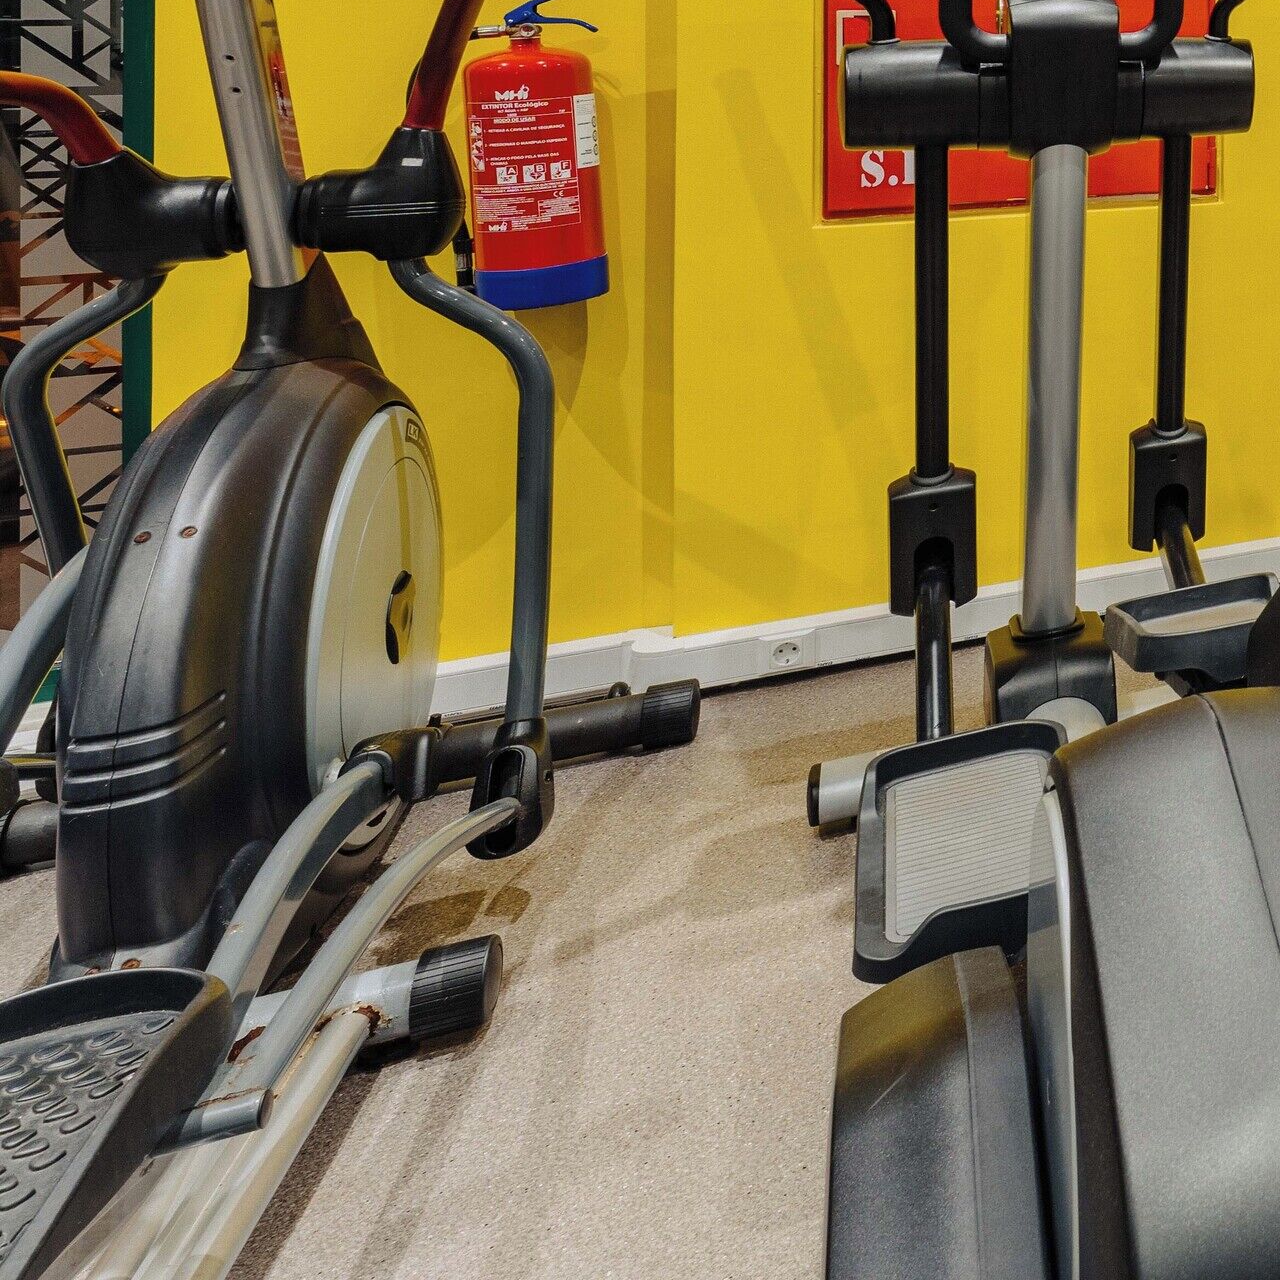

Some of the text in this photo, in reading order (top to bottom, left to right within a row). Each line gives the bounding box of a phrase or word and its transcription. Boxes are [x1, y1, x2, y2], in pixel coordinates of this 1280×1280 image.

[482, 102, 513, 110] EXTINTOR
[562, 161, 569, 169] F
[507, 167, 516, 175] A
